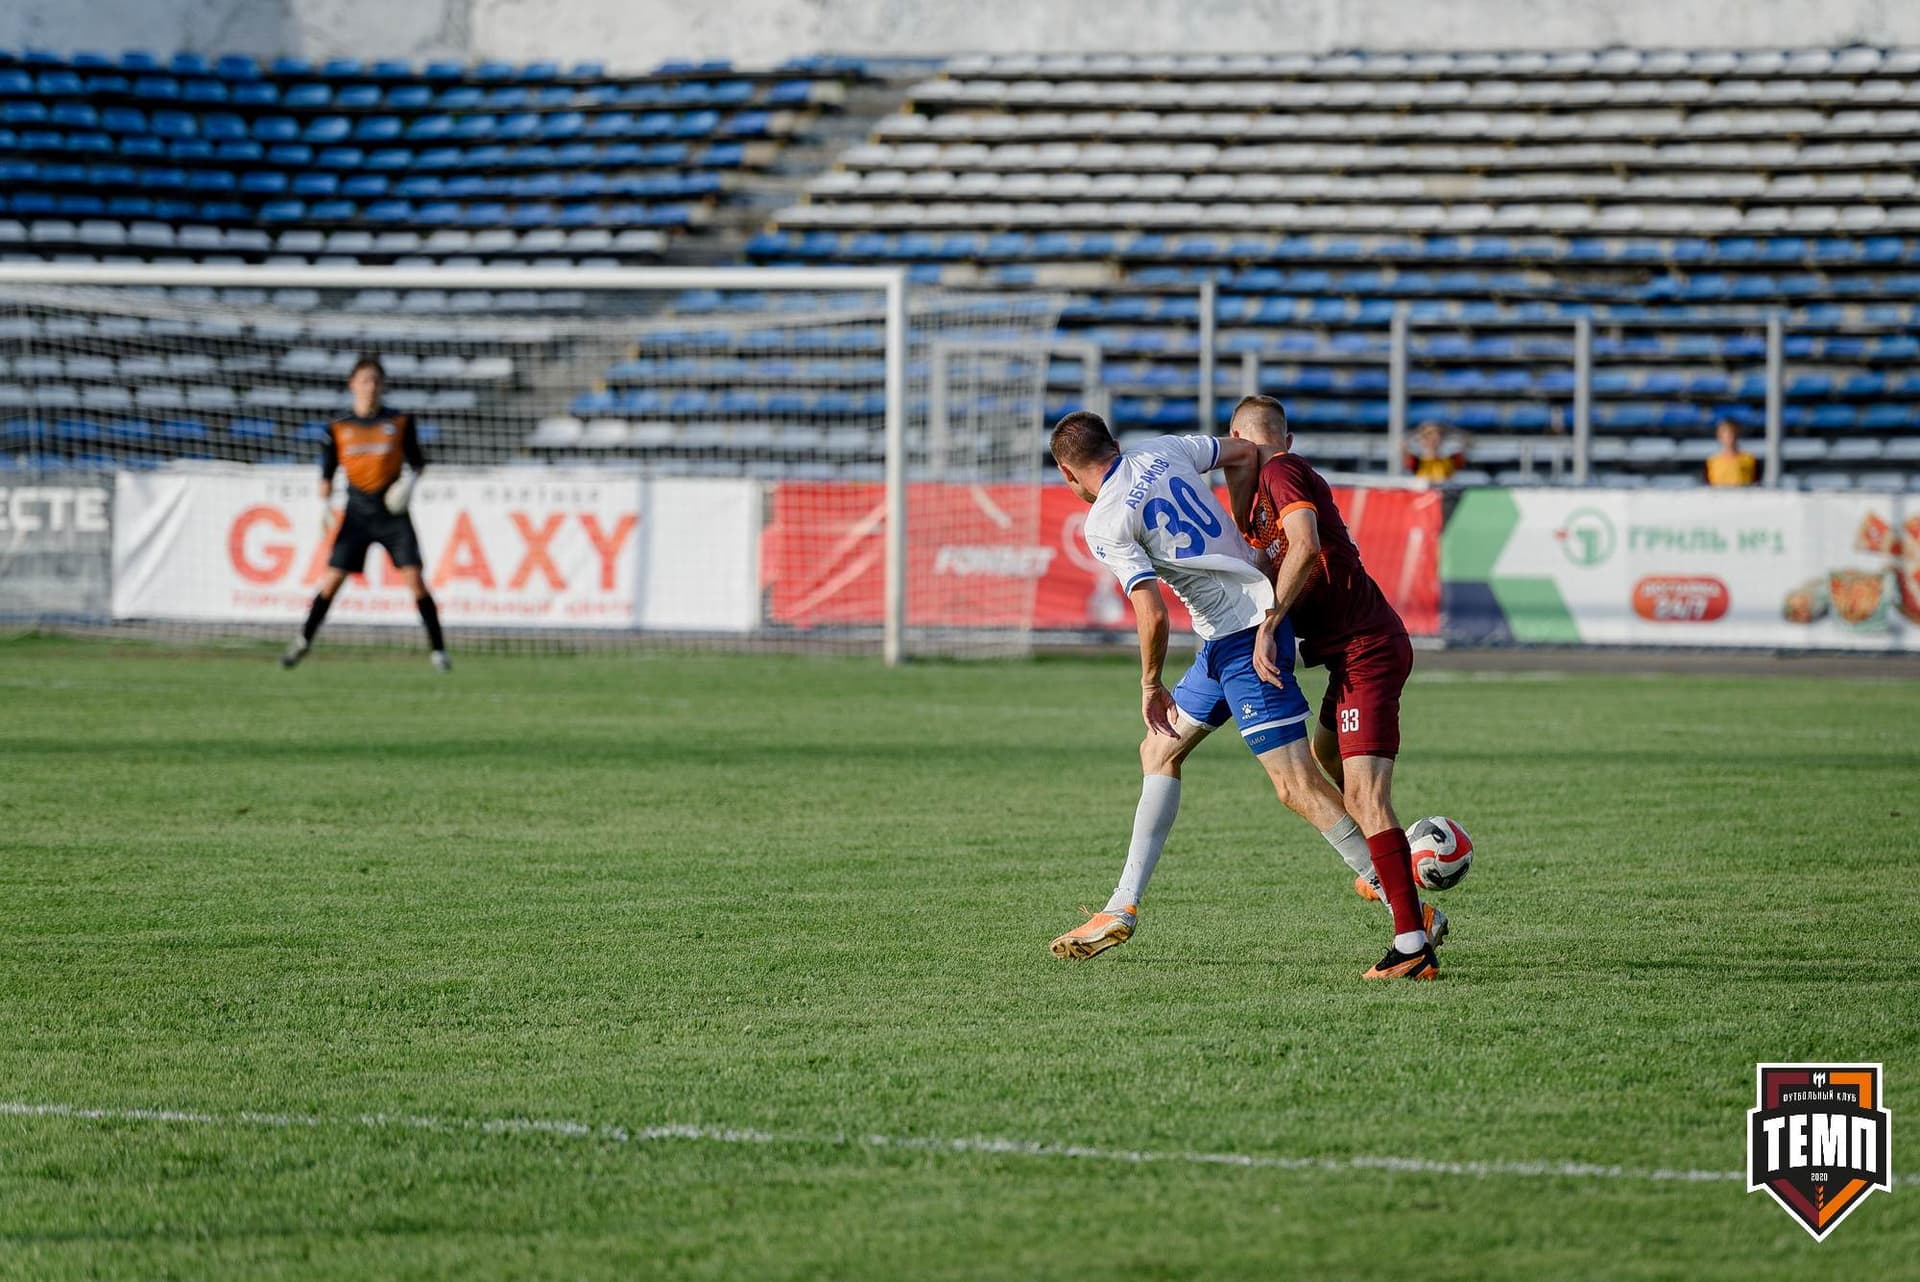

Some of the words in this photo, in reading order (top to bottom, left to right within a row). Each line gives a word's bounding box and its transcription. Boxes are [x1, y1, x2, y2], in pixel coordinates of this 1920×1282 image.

[1125, 457, 1170, 510] АБРАМОВ
[0, 487, 109, 531] СТЕ
[1142, 476, 1222, 560] 30
[1628, 526, 1729, 553] ГРИЛЬ
[1341, 708, 1360, 733] 33
